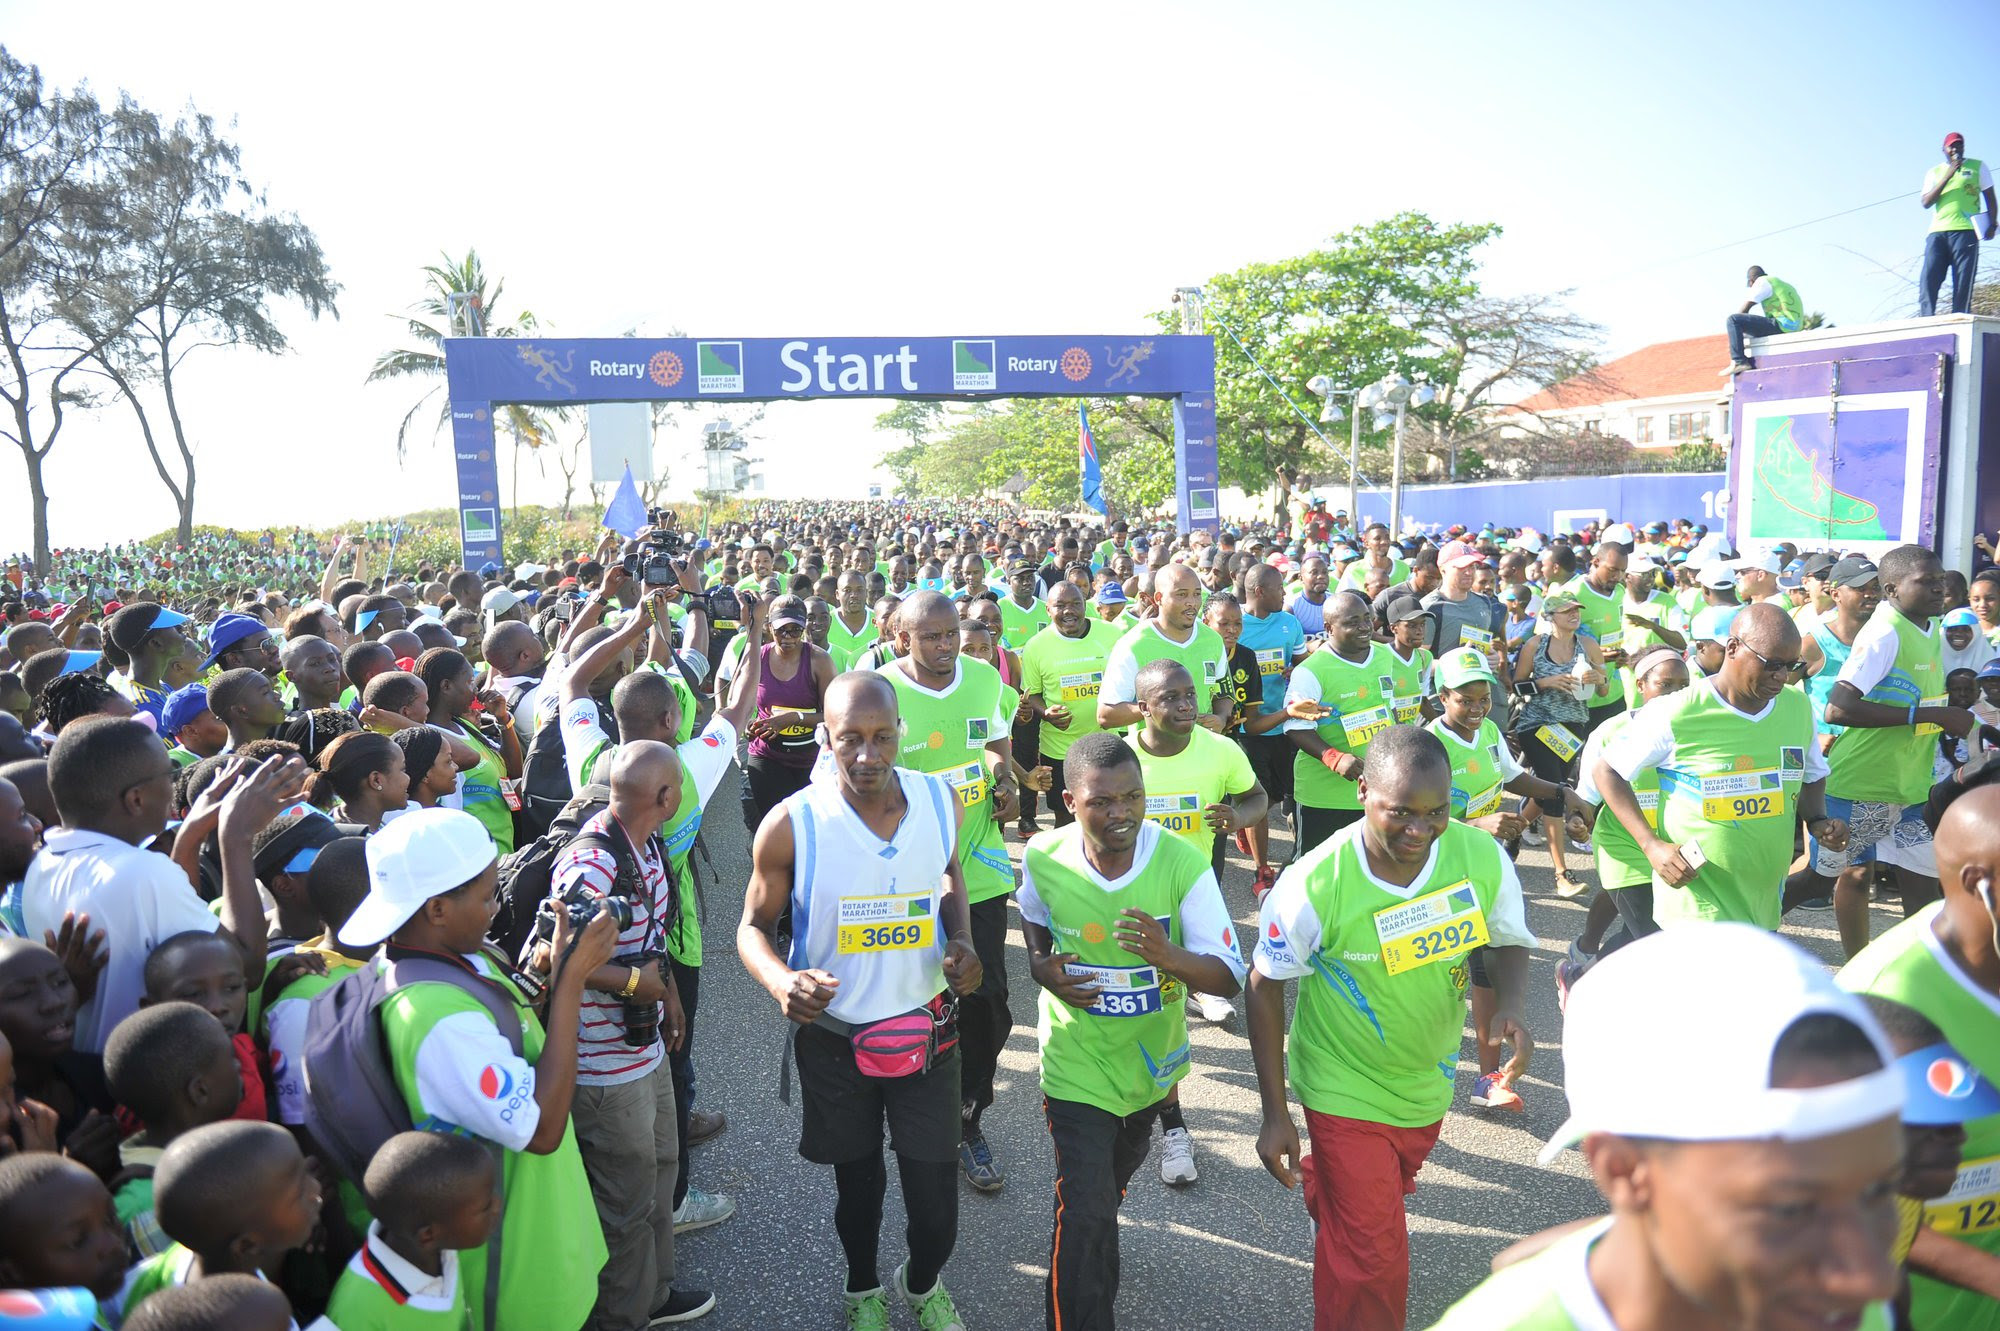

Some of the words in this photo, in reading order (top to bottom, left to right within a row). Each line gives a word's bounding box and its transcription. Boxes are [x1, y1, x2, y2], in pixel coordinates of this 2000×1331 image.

[590, 360, 646, 379] Rotary
[780, 341, 918, 392] Start
[1008, 357, 1058, 374] Rotary
[454, 412, 474, 420] Rotary
[457, 453, 478, 461] Rotary
[460, 493, 481, 501] Rotary
[465, 549, 485, 557] Rotary
[1074, 686, 1100, 697] 1043
[903, 741, 928, 754] Rotary
[960, 785, 980, 804] 75
[1704, 783, 1743, 792] MARATHON
[1733, 797, 1771, 817] 902
[842, 902, 871, 910] ROTARY
[842, 909, 888, 917] MARATHON
[1380, 910, 1409, 926] ROTARY
[1411, 904, 1427, 915] DAR
[1381, 912, 1429, 933] MARATHON
[862, 924, 921, 948] 3669
[1411, 920, 1478, 960] 3292
[1343, 950, 1379, 962] Rotary
[511, 973, 540, 997] Canon
[1092, 993, 1148, 1014] 4361
[278, 1081, 299, 1096] psi
[1970, 1167, 1992, 1177] DAR
[1953, 1177, 1991, 1190] ATHON
[1959, 1200, 2000, 1230] 12
